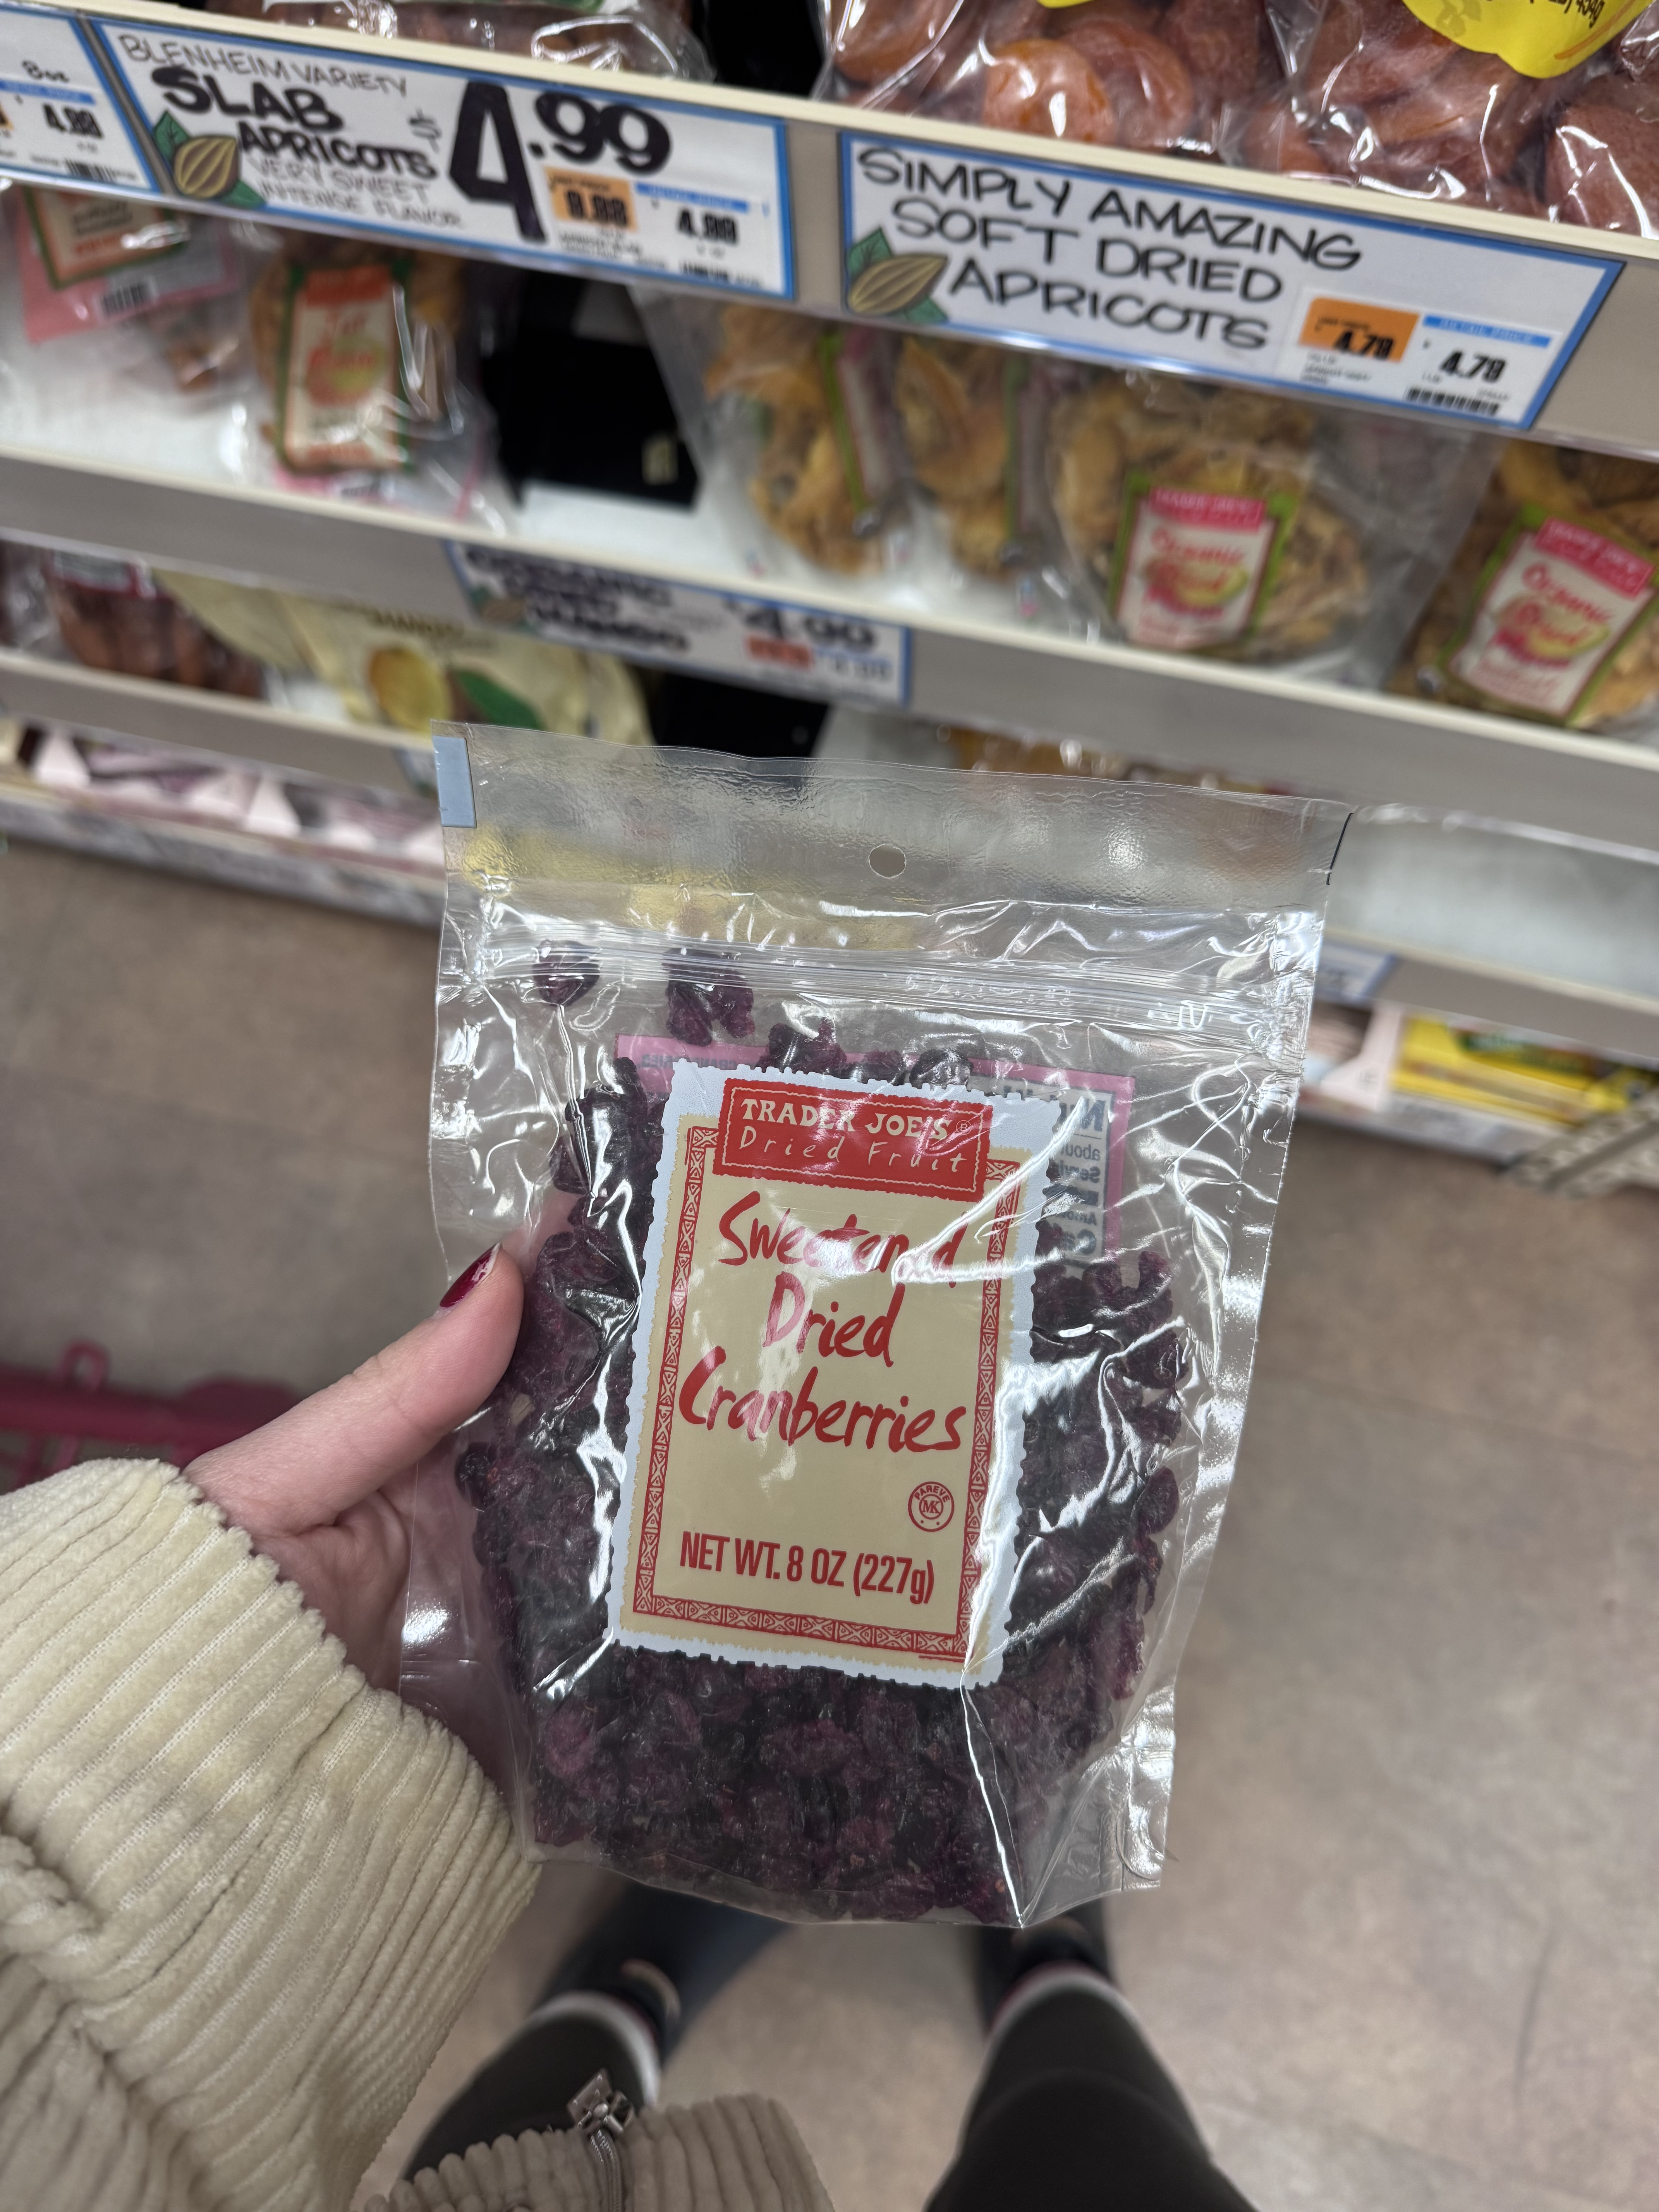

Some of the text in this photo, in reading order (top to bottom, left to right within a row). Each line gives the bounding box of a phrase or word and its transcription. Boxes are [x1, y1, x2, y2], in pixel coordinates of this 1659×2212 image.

[118, 34, 407, 97] BLENHEIM VARIETY
[151, 65, 343, 132] SLAB
[237, 121, 438, 180] APRICOTS
[449, 80, 672, 243] 4.99
[331, 169, 429, 205] SWEET
[857, 147, 1361, 270] SIMPLY AMAZING
[892, 198, 1283, 302] SOFT DRIED
[950, 258, 1268, 349] APRICOTS
[740, 1099, 952, 1140] TRADER JOE'S
[740, 1125, 968, 1173] Dried Fruit
[718, 1190, 968, 1287] Sweetend
[763, 1271, 905, 1367] Dried
[679, 1346, 967, 1452] Cranberries
[914, 1485, 950, 1503] PAREVE
[922, 1499, 941, 1514] MK
[680, 1531, 934, 1604] NET WT. 8 OZ (227g)
